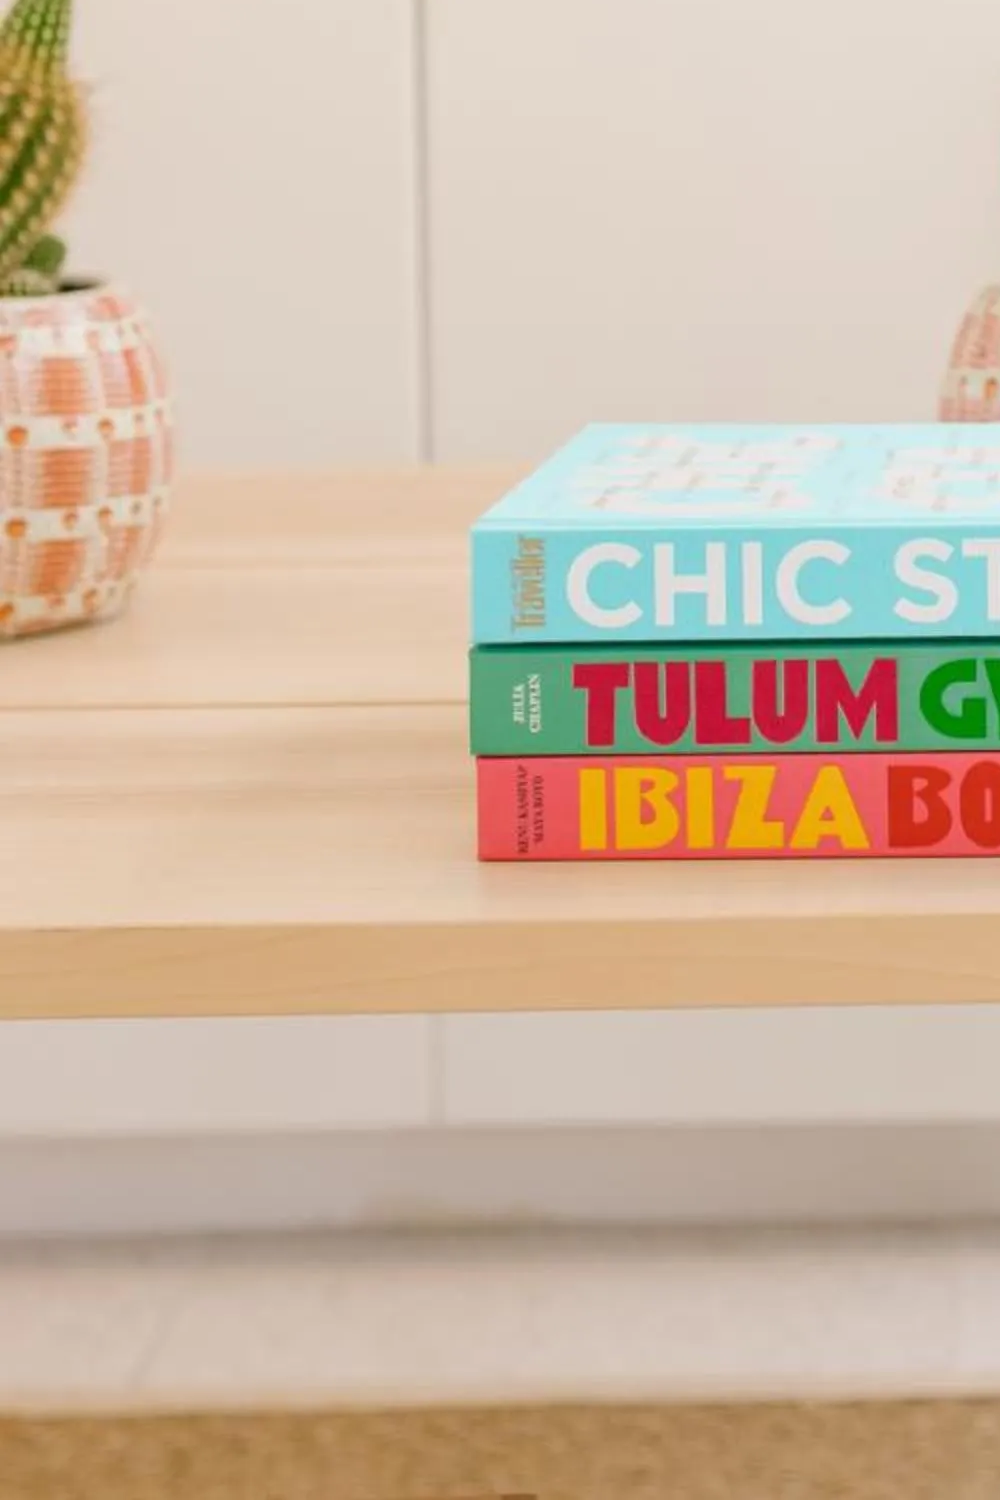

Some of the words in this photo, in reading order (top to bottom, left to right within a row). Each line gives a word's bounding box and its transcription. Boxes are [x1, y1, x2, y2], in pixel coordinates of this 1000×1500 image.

[567, 541, 851, 628] CHIC
[573, 658, 898, 746] TULUM
[579, 764, 870, 851] IBIZA
